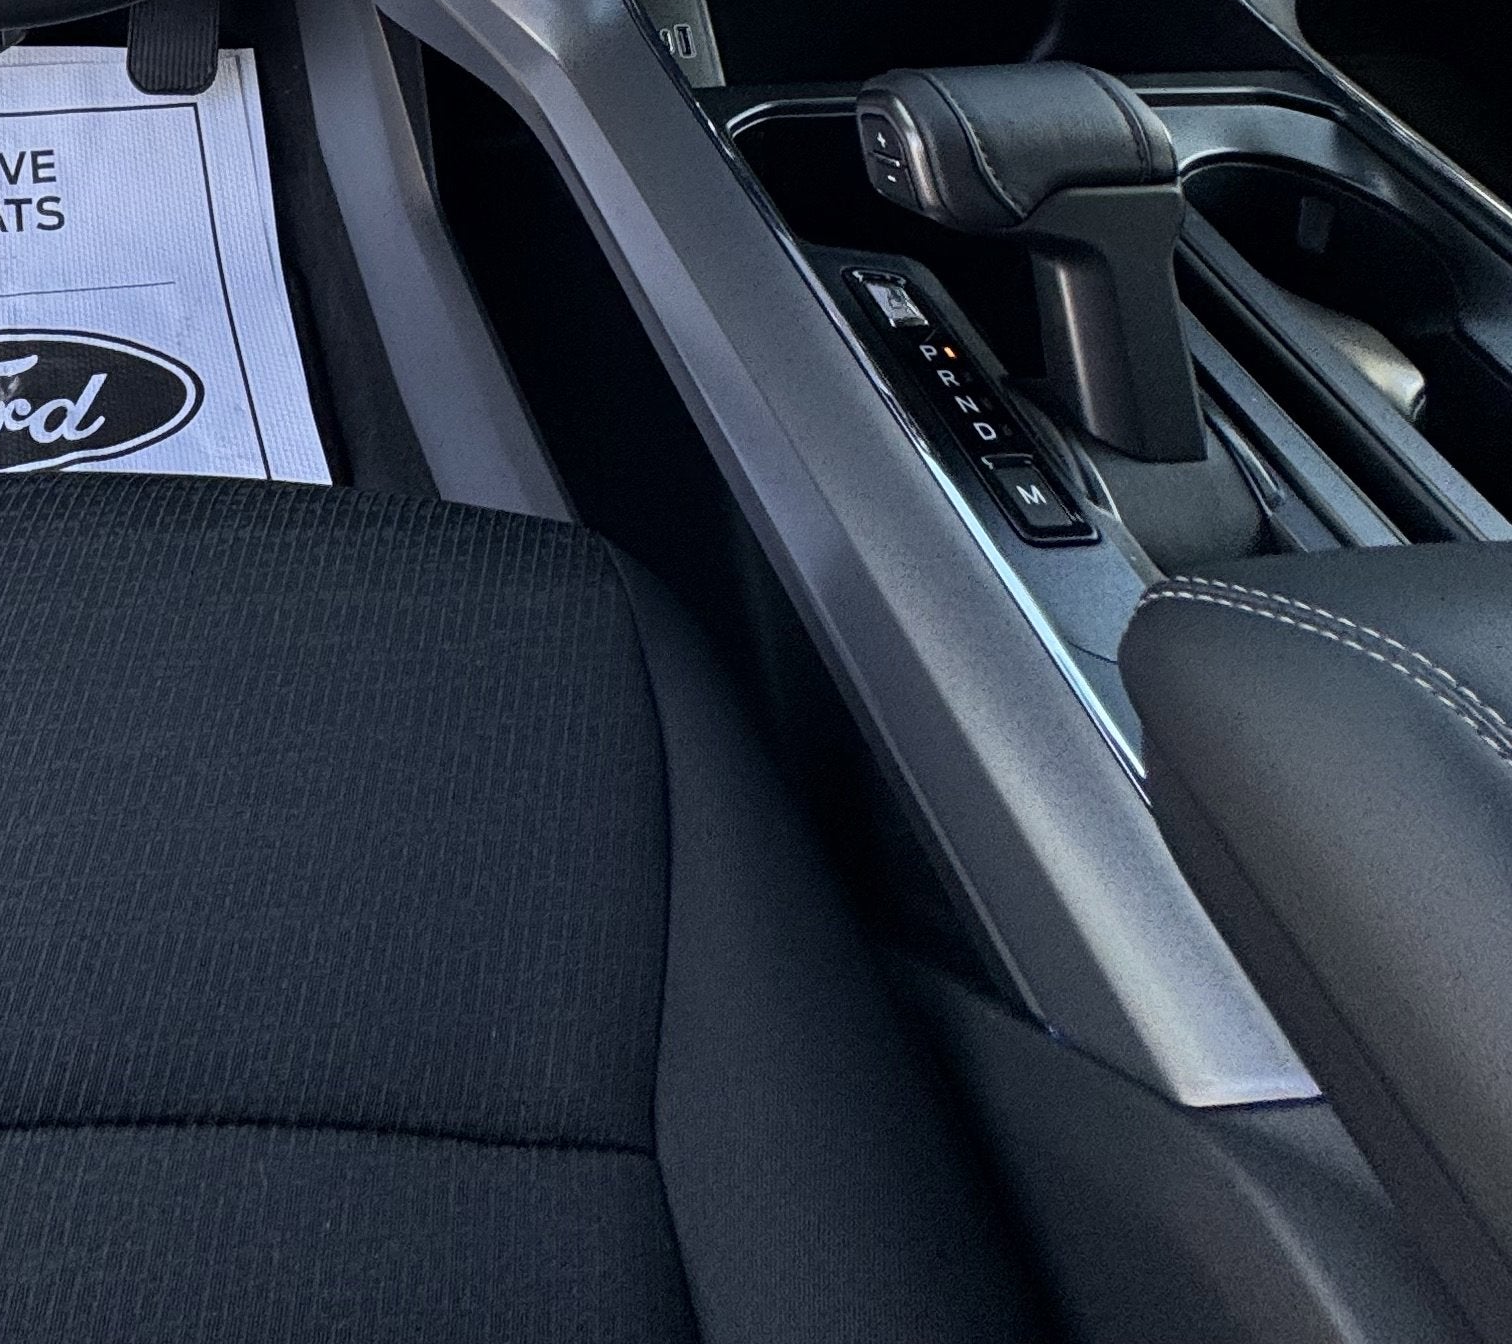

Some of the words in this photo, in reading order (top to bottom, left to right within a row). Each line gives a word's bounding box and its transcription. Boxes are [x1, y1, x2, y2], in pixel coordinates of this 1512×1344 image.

[918, 343, 939, 362] P
[936, 369, 961, 389] R
[954, 395, 981, 415] N
[973, 422, 997, 442] D
[1015, 484, 1047, 506] M
